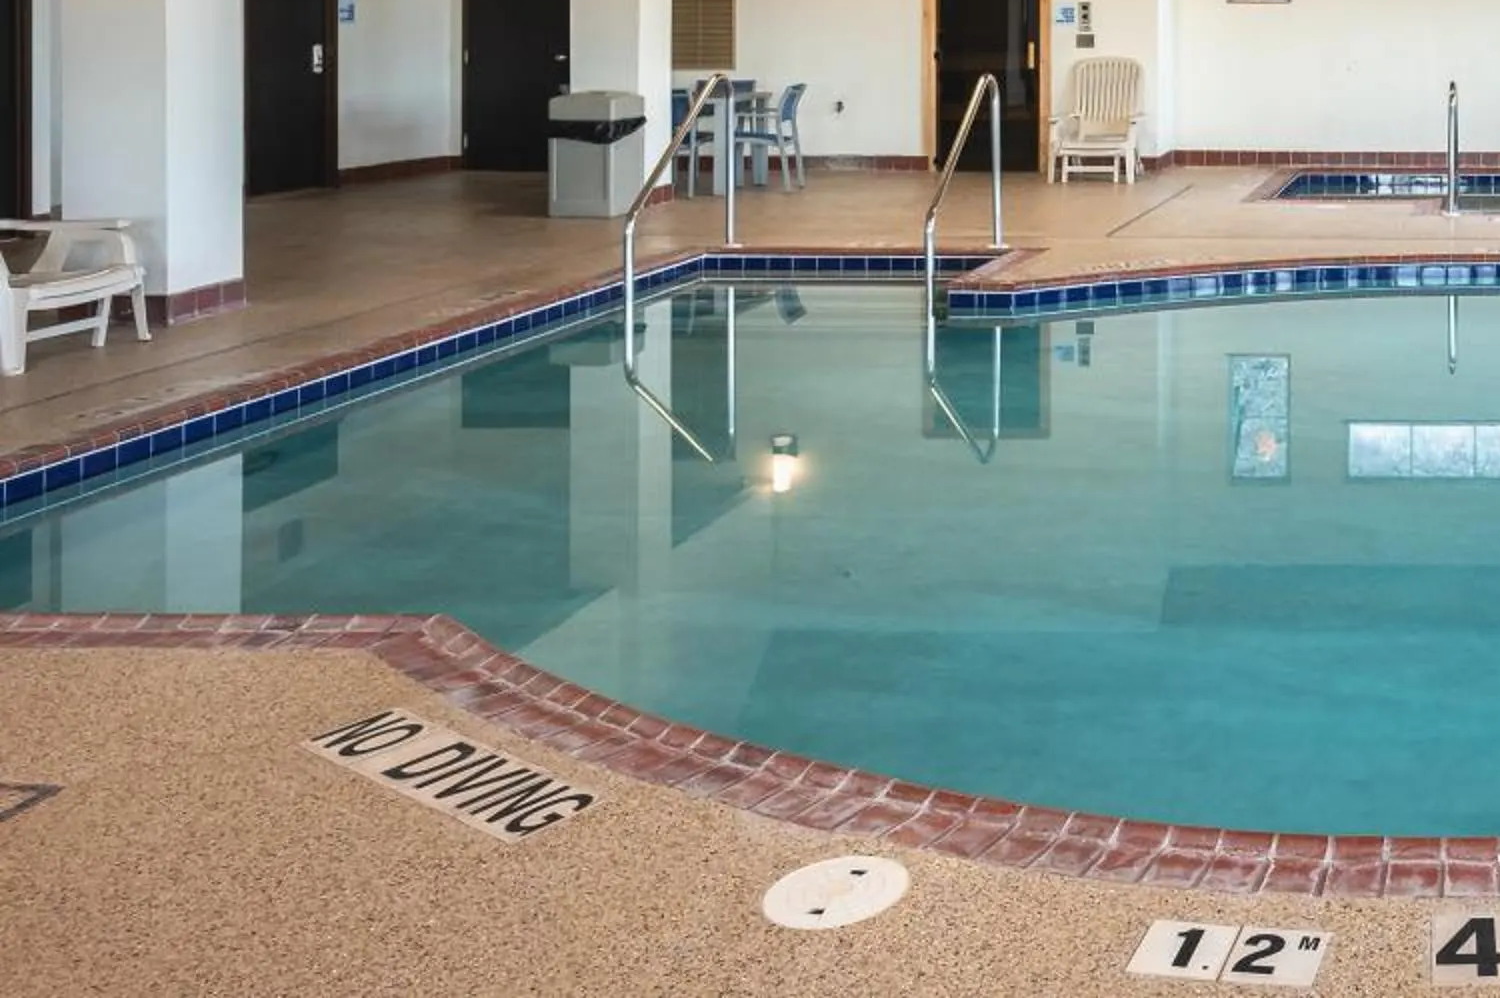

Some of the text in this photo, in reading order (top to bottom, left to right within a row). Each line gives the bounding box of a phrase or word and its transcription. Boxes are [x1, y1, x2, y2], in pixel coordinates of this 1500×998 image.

[310, 710, 594, 836] NO DIVING
[1298, 936, 1321, 951] M
